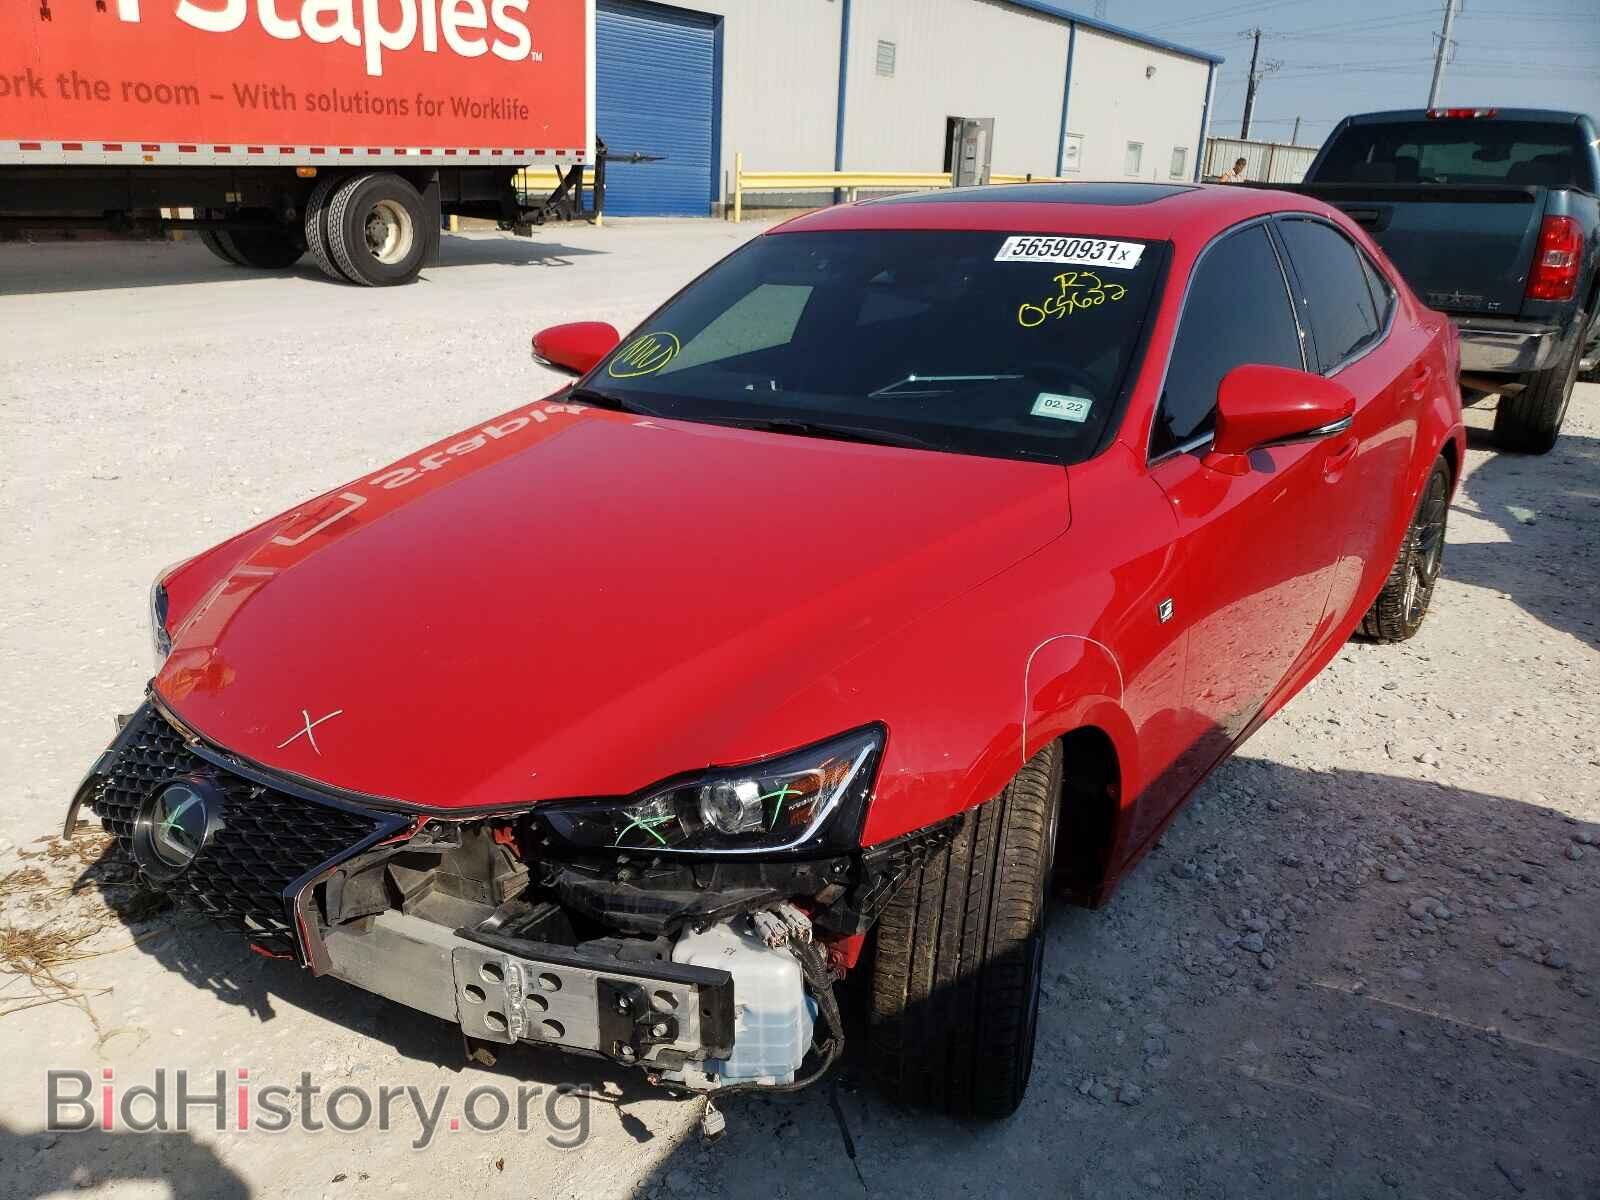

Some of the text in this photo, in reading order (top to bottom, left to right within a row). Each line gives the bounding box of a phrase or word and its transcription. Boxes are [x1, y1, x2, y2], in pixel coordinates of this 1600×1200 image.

[56, 70, 111, 101] the
[121, 81, 200, 105] room
[232, 83, 297, 110] With
[305, 88, 409, 116] solutions
[416, 93, 445, 117] for
[450, 97, 529, 120] Worklife
